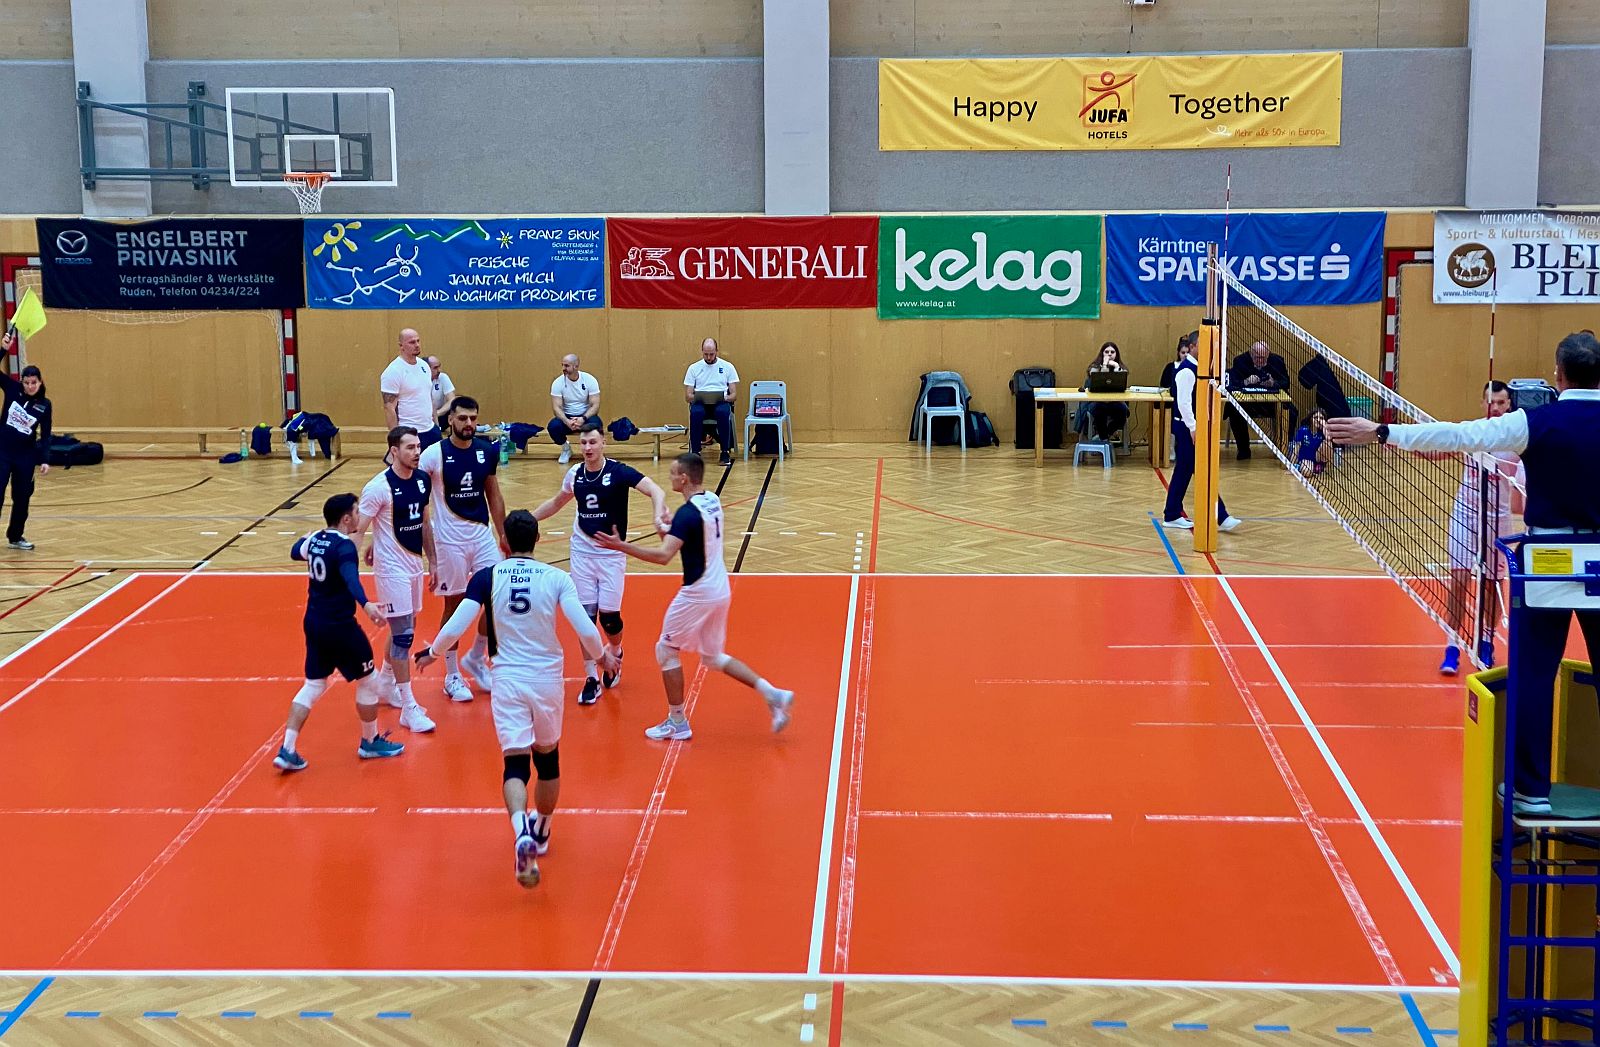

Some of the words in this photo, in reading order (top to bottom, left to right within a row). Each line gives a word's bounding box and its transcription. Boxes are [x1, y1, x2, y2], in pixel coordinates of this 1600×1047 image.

[953, 97, 1038, 122] Happy
[1169, 91, 1290, 120] Together
[1088, 108, 1128, 123] JUFA
[1088, 131, 1128, 139] HOTELS
[1234, 128, 1253, 137] Mehr
[1256, 128, 1269, 136] als
[1289, 128, 1296, 136] in
[1479, 213, 1544, 225] WILLKOMMEN
[115, 230, 248, 248] ENGELBERT
[519, 229, 563, 240] FRANZ
[568, 229, 600, 240] SKUK
[1488, 229, 1496, 239] &
[1501, 228, 1565, 239] Kulturstadt
[117, 249, 239, 266] PRIVASNIK
[678, 245, 869, 280] GENERALI
[1511, 243, 1600, 270] BLEI
[895, 227, 1082, 306] kelag
[119, 273, 202, 286] Vertragshändler
[207, 274, 214, 283] &
[218, 273, 275, 284] Werkstätte
[448, 273, 511, 285] JAUNTAL
[1536, 271, 1600, 297] PLI
[119, 286, 156, 297] Ruden,
[160, 286, 197, 296] Telefon
[200, 286, 260, 297] 04234/224
[419, 289, 449, 301] UND
[453, 289, 517, 302] JOGHURT
[521, 288, 597, 303] PRODUKTE
[895, 300, 956, 308] www.kelag.at
[460, 472, 473, 487] 4
[585, 493, 599, 509] 2
[400, 523, 423, 532] FOXCON
[715, 517, 720, 538] 1
[308, 553, 327, 581] 10
[510, 574, 531, 583] Boa
[440, 582, 448, 591] 4
[508, 586, 532, 615] 5
